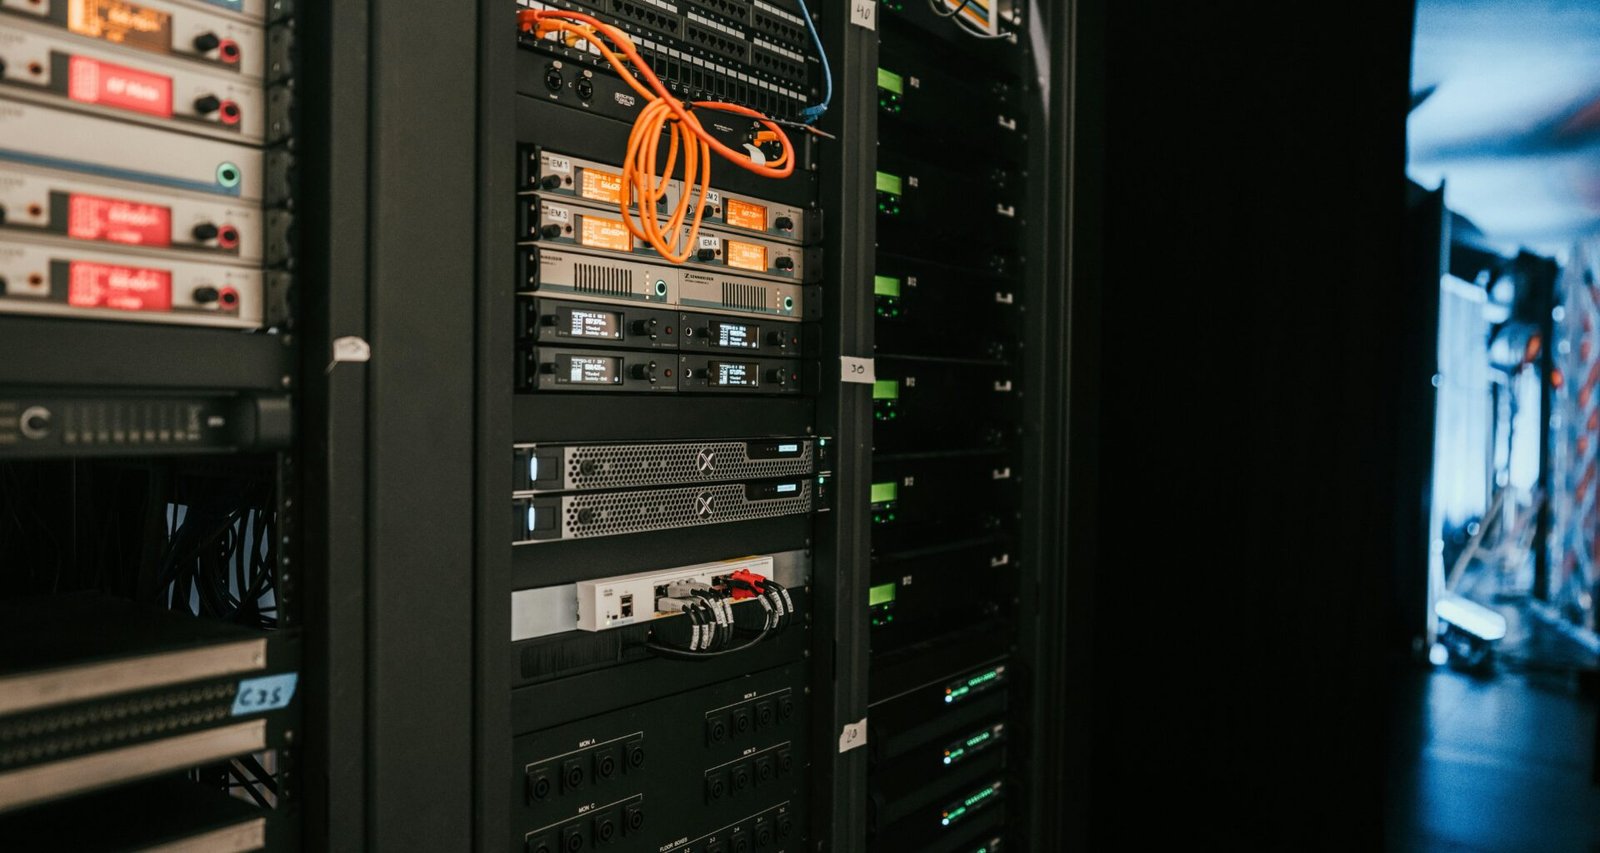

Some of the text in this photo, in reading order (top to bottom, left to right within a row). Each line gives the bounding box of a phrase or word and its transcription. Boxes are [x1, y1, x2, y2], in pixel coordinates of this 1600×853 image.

[856, 3, 871, 20] 40
[851, 363, 865, 374] 30
[578, 739, 591, 748] MON
[578, 804, 590, 813] MON
